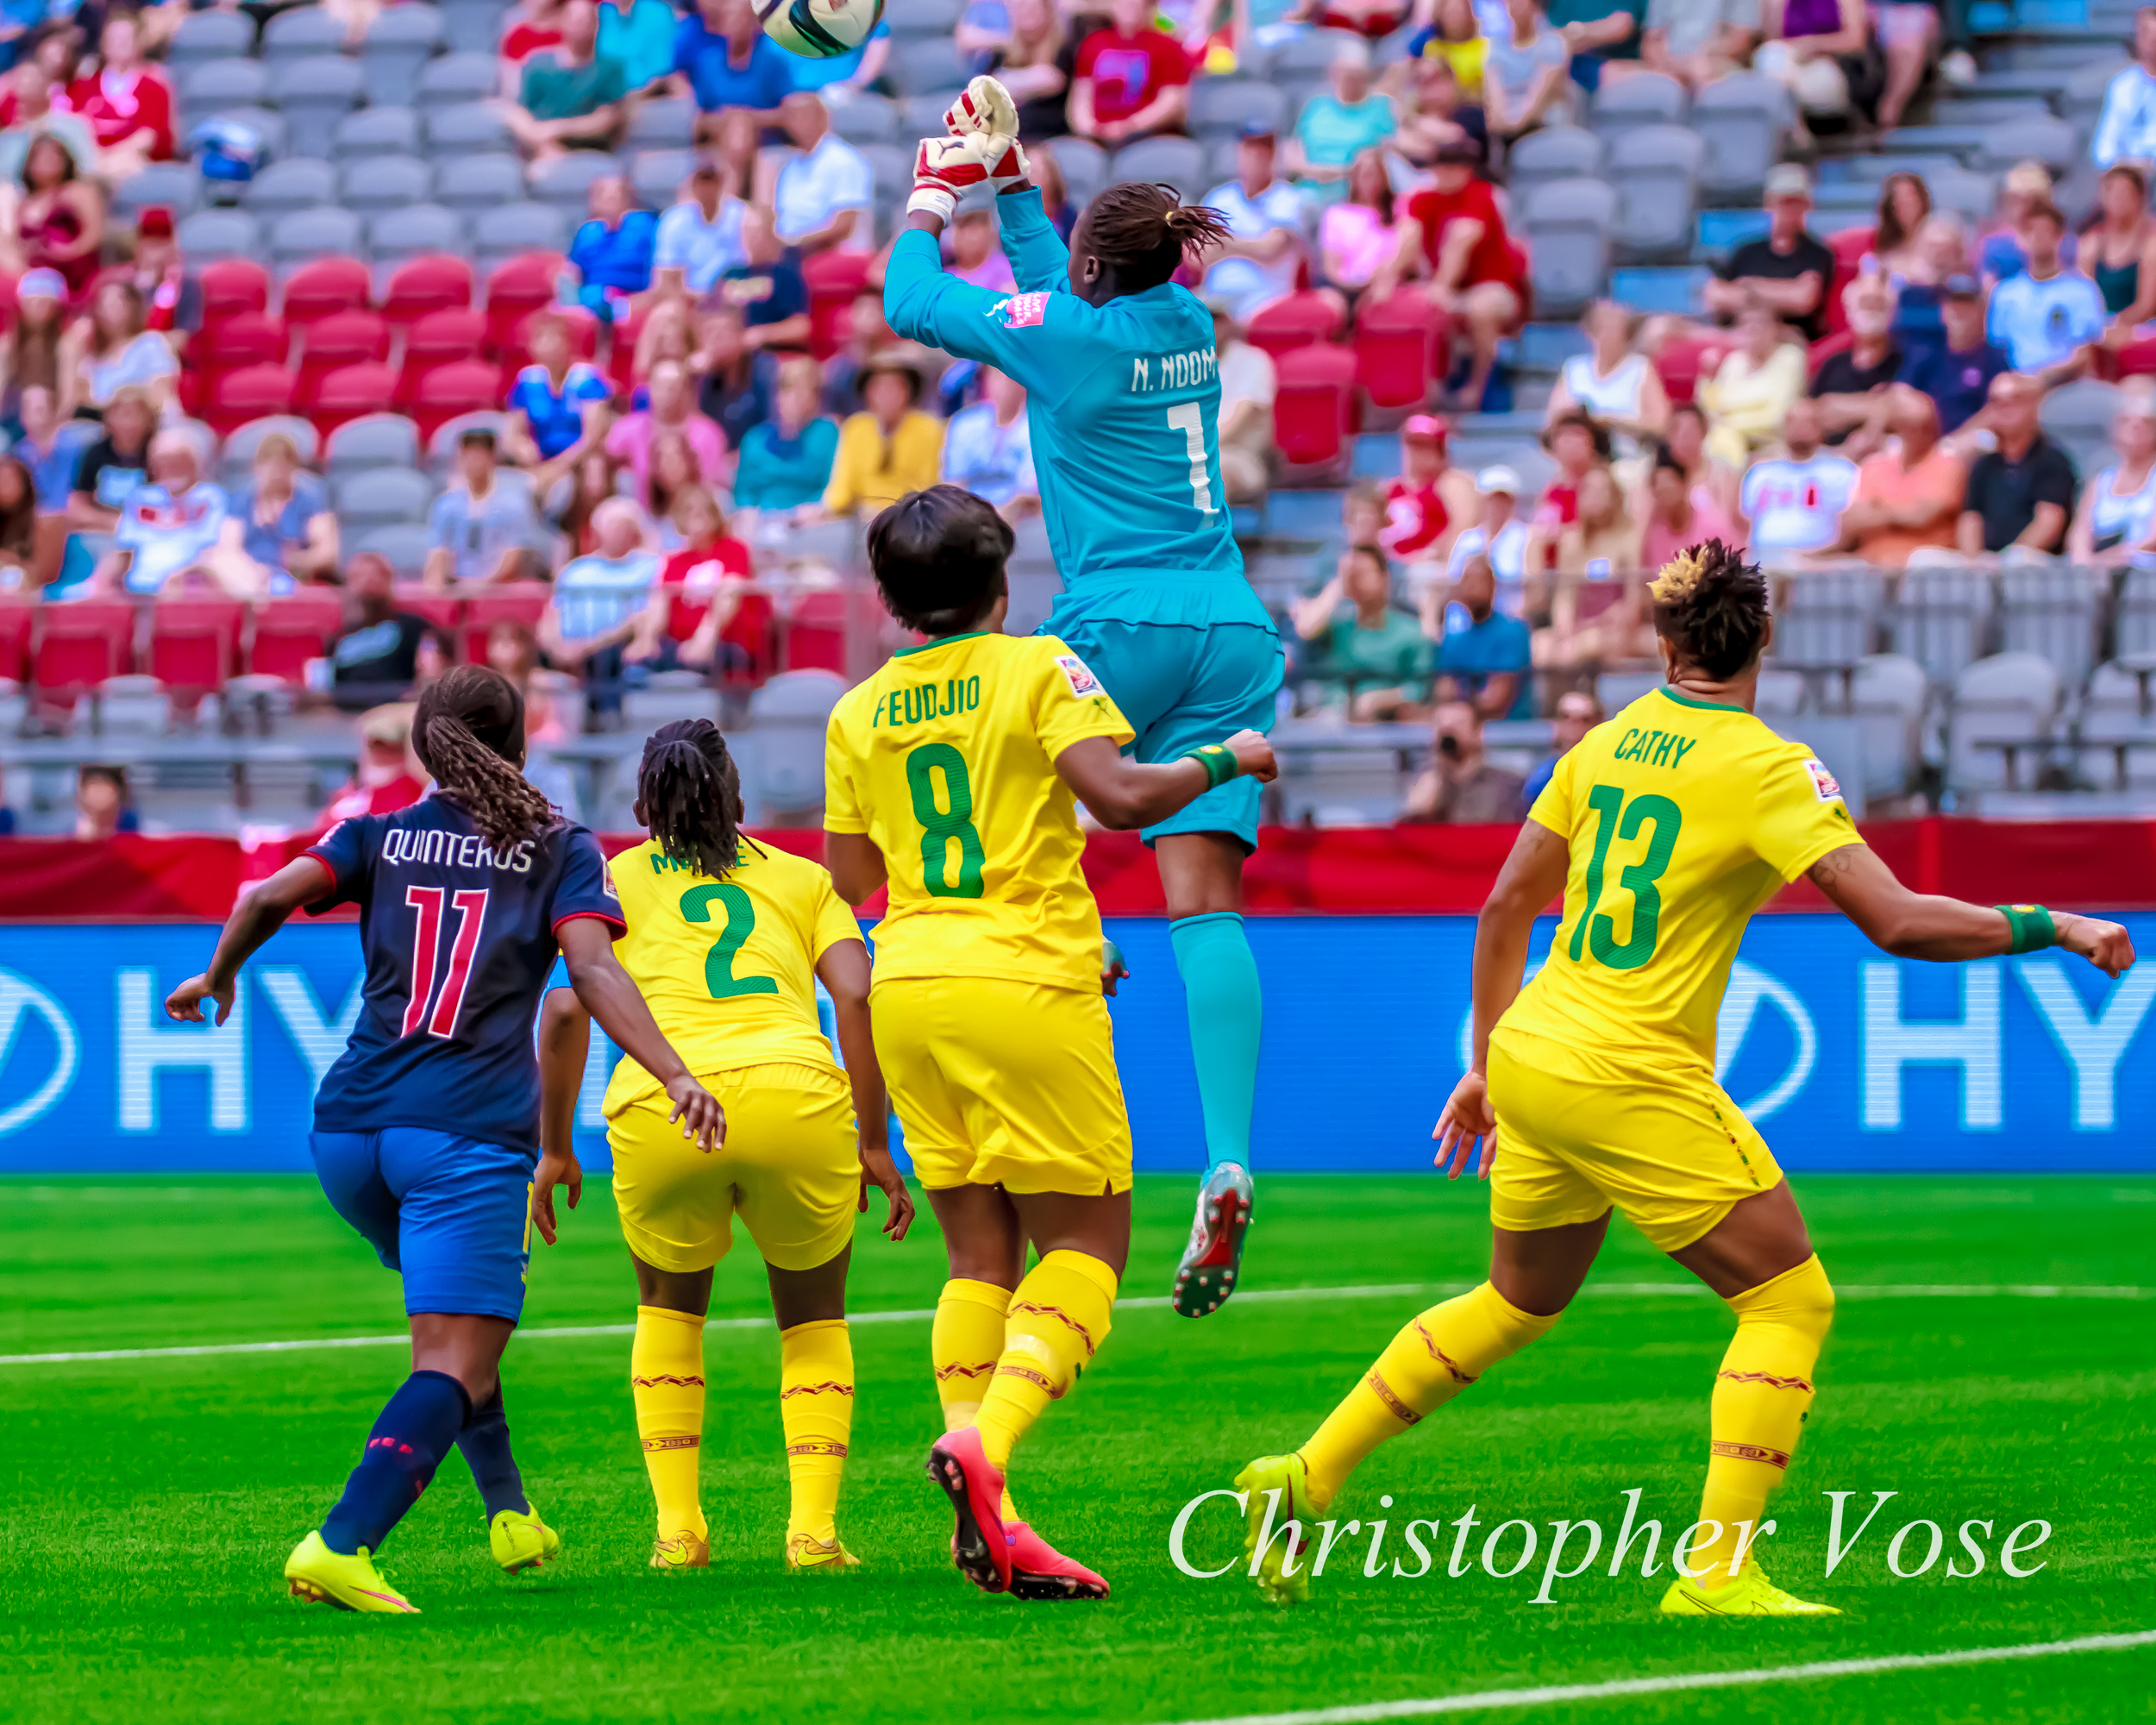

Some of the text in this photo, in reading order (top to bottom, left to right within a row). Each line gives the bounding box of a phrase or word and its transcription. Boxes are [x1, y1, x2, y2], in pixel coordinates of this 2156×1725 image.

[1022, 294, 1031, 322] YOUR
[1031, 293, 1042, 313] LIVE
[1131, 345, 1216, 392] N. NDOM
[1167, 401, 1219, 530] 1
[873, 674, 980, 728] FEUDJIO
[1614, 728, 1697, 769] CATHY
[906, 742, 987, 900] 8
[1569, 784, 1683, 970] 13
[400, 884, 491, 1039] 11
[679, 883, 780, 1000] 2
